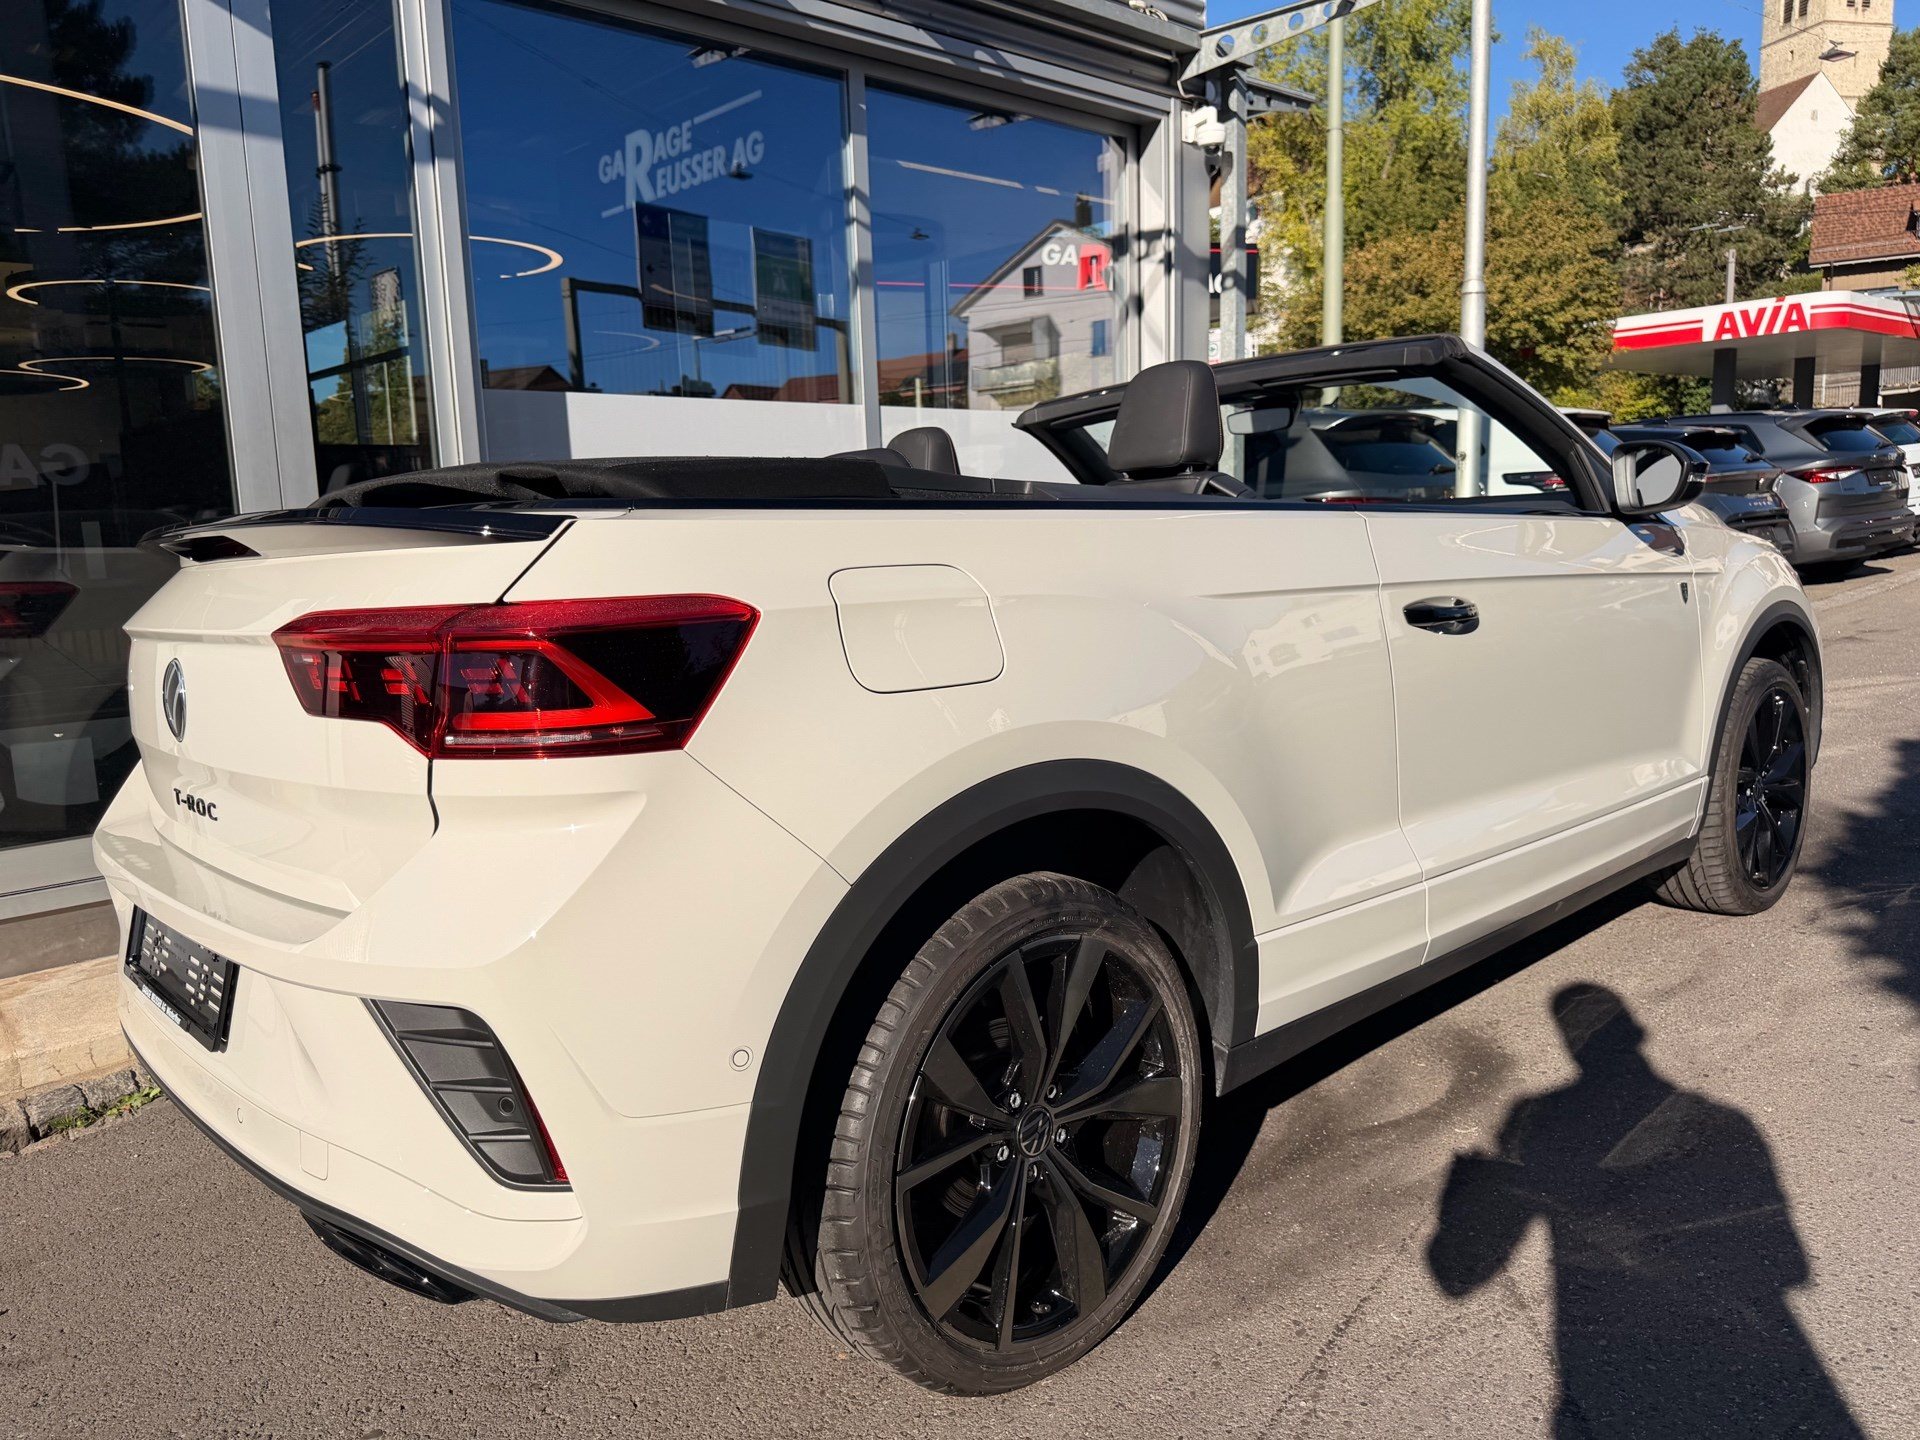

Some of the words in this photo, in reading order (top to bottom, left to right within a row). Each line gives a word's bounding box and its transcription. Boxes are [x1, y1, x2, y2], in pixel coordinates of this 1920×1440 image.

[599, 119, 693, 209] GARAGE
[731, 130, 765, 175] AG
[1041, 244, 1113, 291] GAR
[1713, 296, 1809, 341] AVIA
[173, 788, 218, 821] T-ROC
